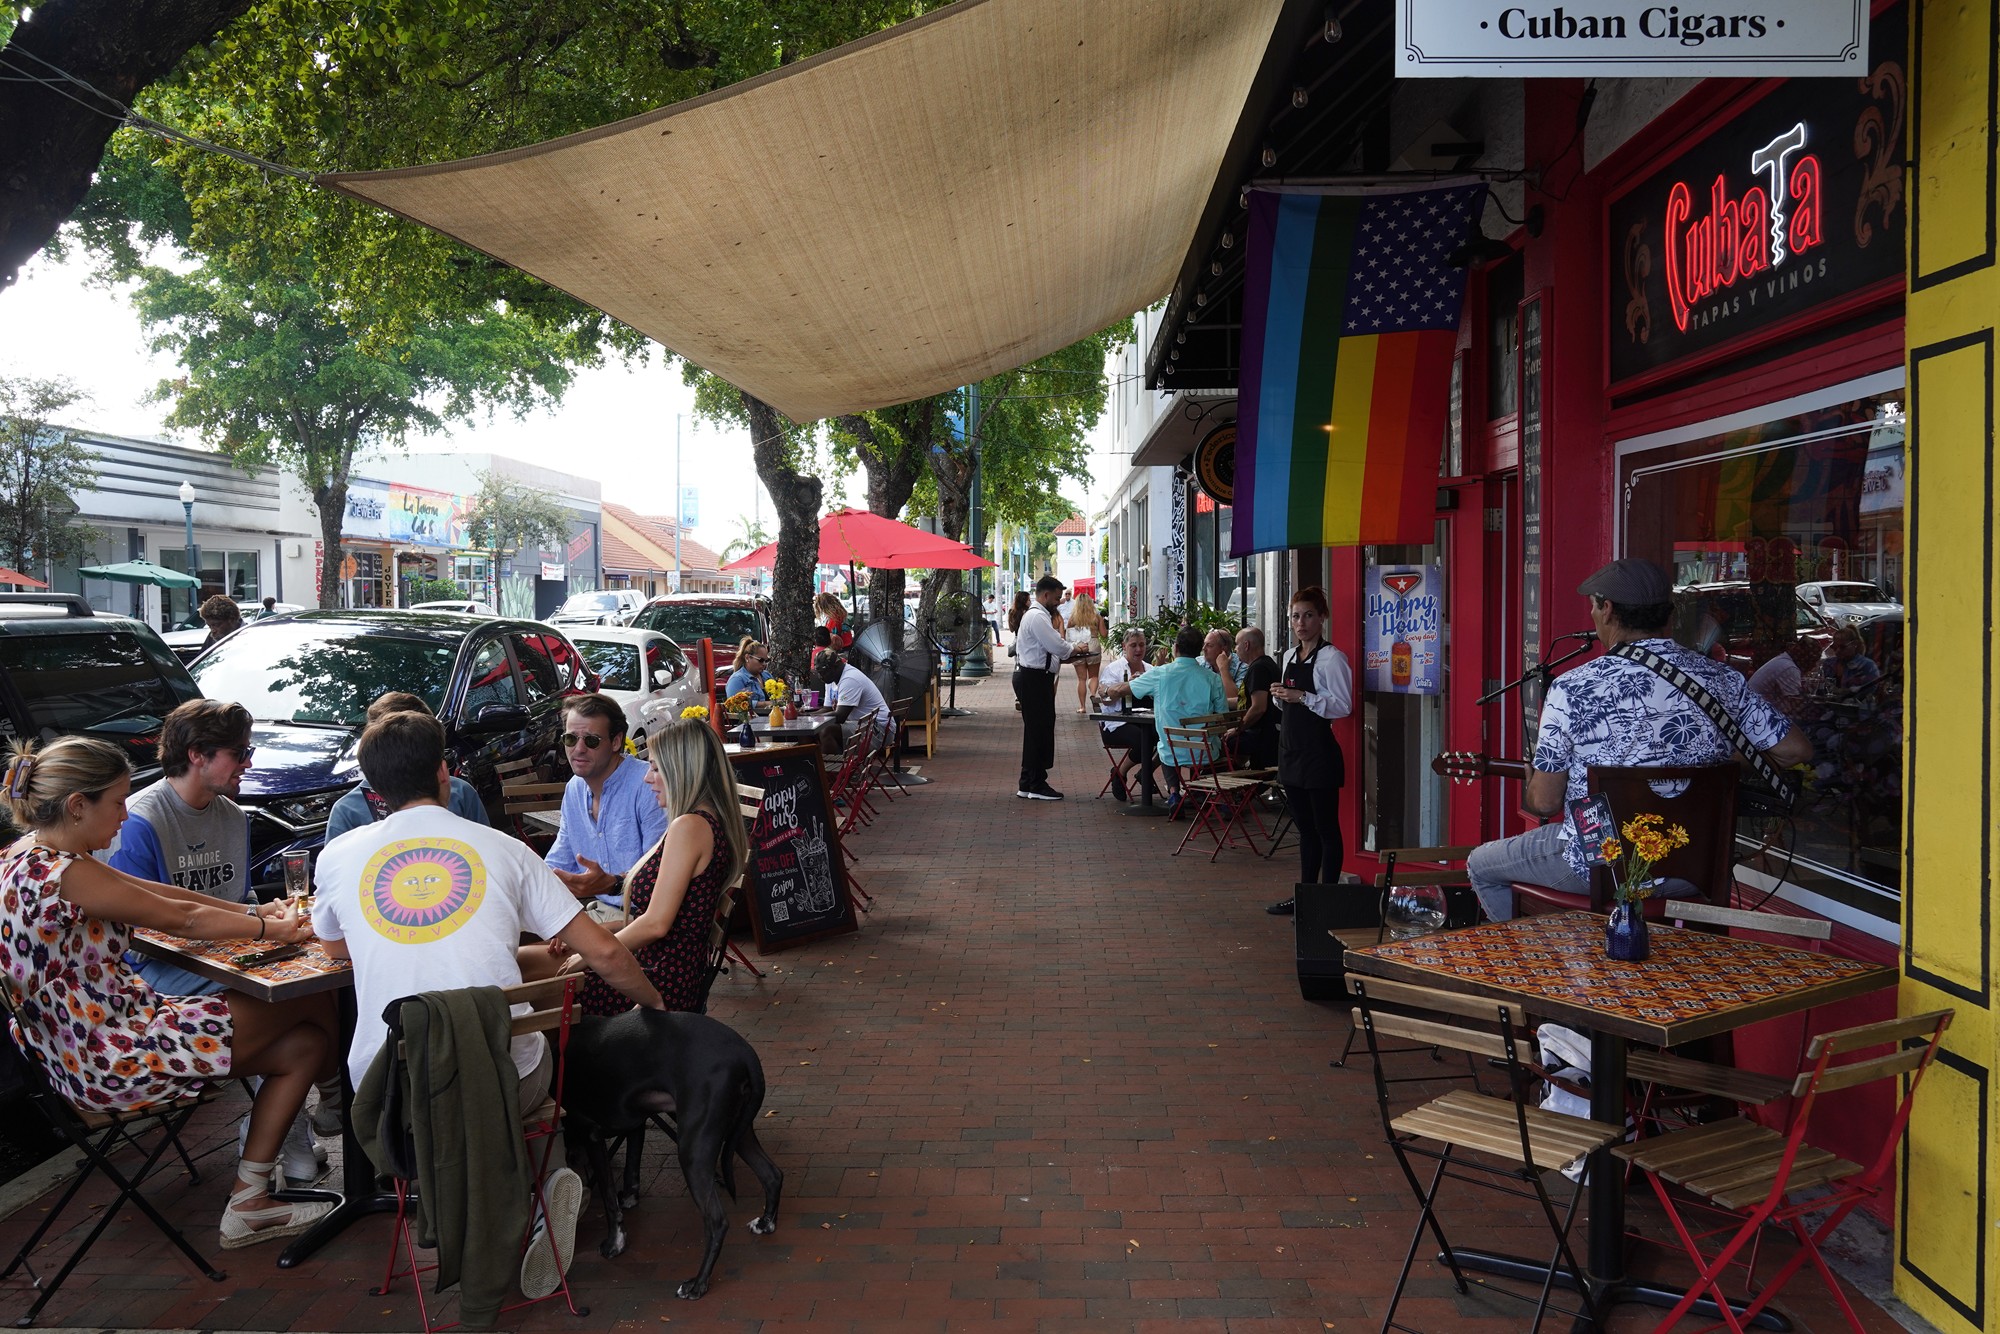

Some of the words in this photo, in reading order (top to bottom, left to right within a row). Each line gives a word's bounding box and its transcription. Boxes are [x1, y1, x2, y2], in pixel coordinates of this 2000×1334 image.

[1499, 8, 1627, 39] Cuban
[1638, 6, 1767, 47] Cigars
[1692, 296, 1740, 331] TAPAS
[1749, 288, 1758, 306] Y
[1766, 257, 1828, 299] VINOS
[351, 506, 383, 520] JEWELRY
[1369, 594, 1438, 620] Happy
[1381, 608, 1438, 637] Hour!
[1404, 634, 1422, 642] Every
[1423, 632, 1437, 642] day!
[1378, 650, 1389, 658] OFF
[766, 837, 778, 849] EVERY
[362, 842, 408, 898] POLER
[418, 839, 484, 869] STUFF
[758, 855, 778, 873] 50%
[779, 851, 796, 868] OFF
[767, 870, 785, 879] Alcoholic
[785, 867, 799, 876] Drinks
[771, 878, 794, 899] Enjoy
[366, 904, 417, 940] CAMP
[431, 879, 485, 936] VIBES
